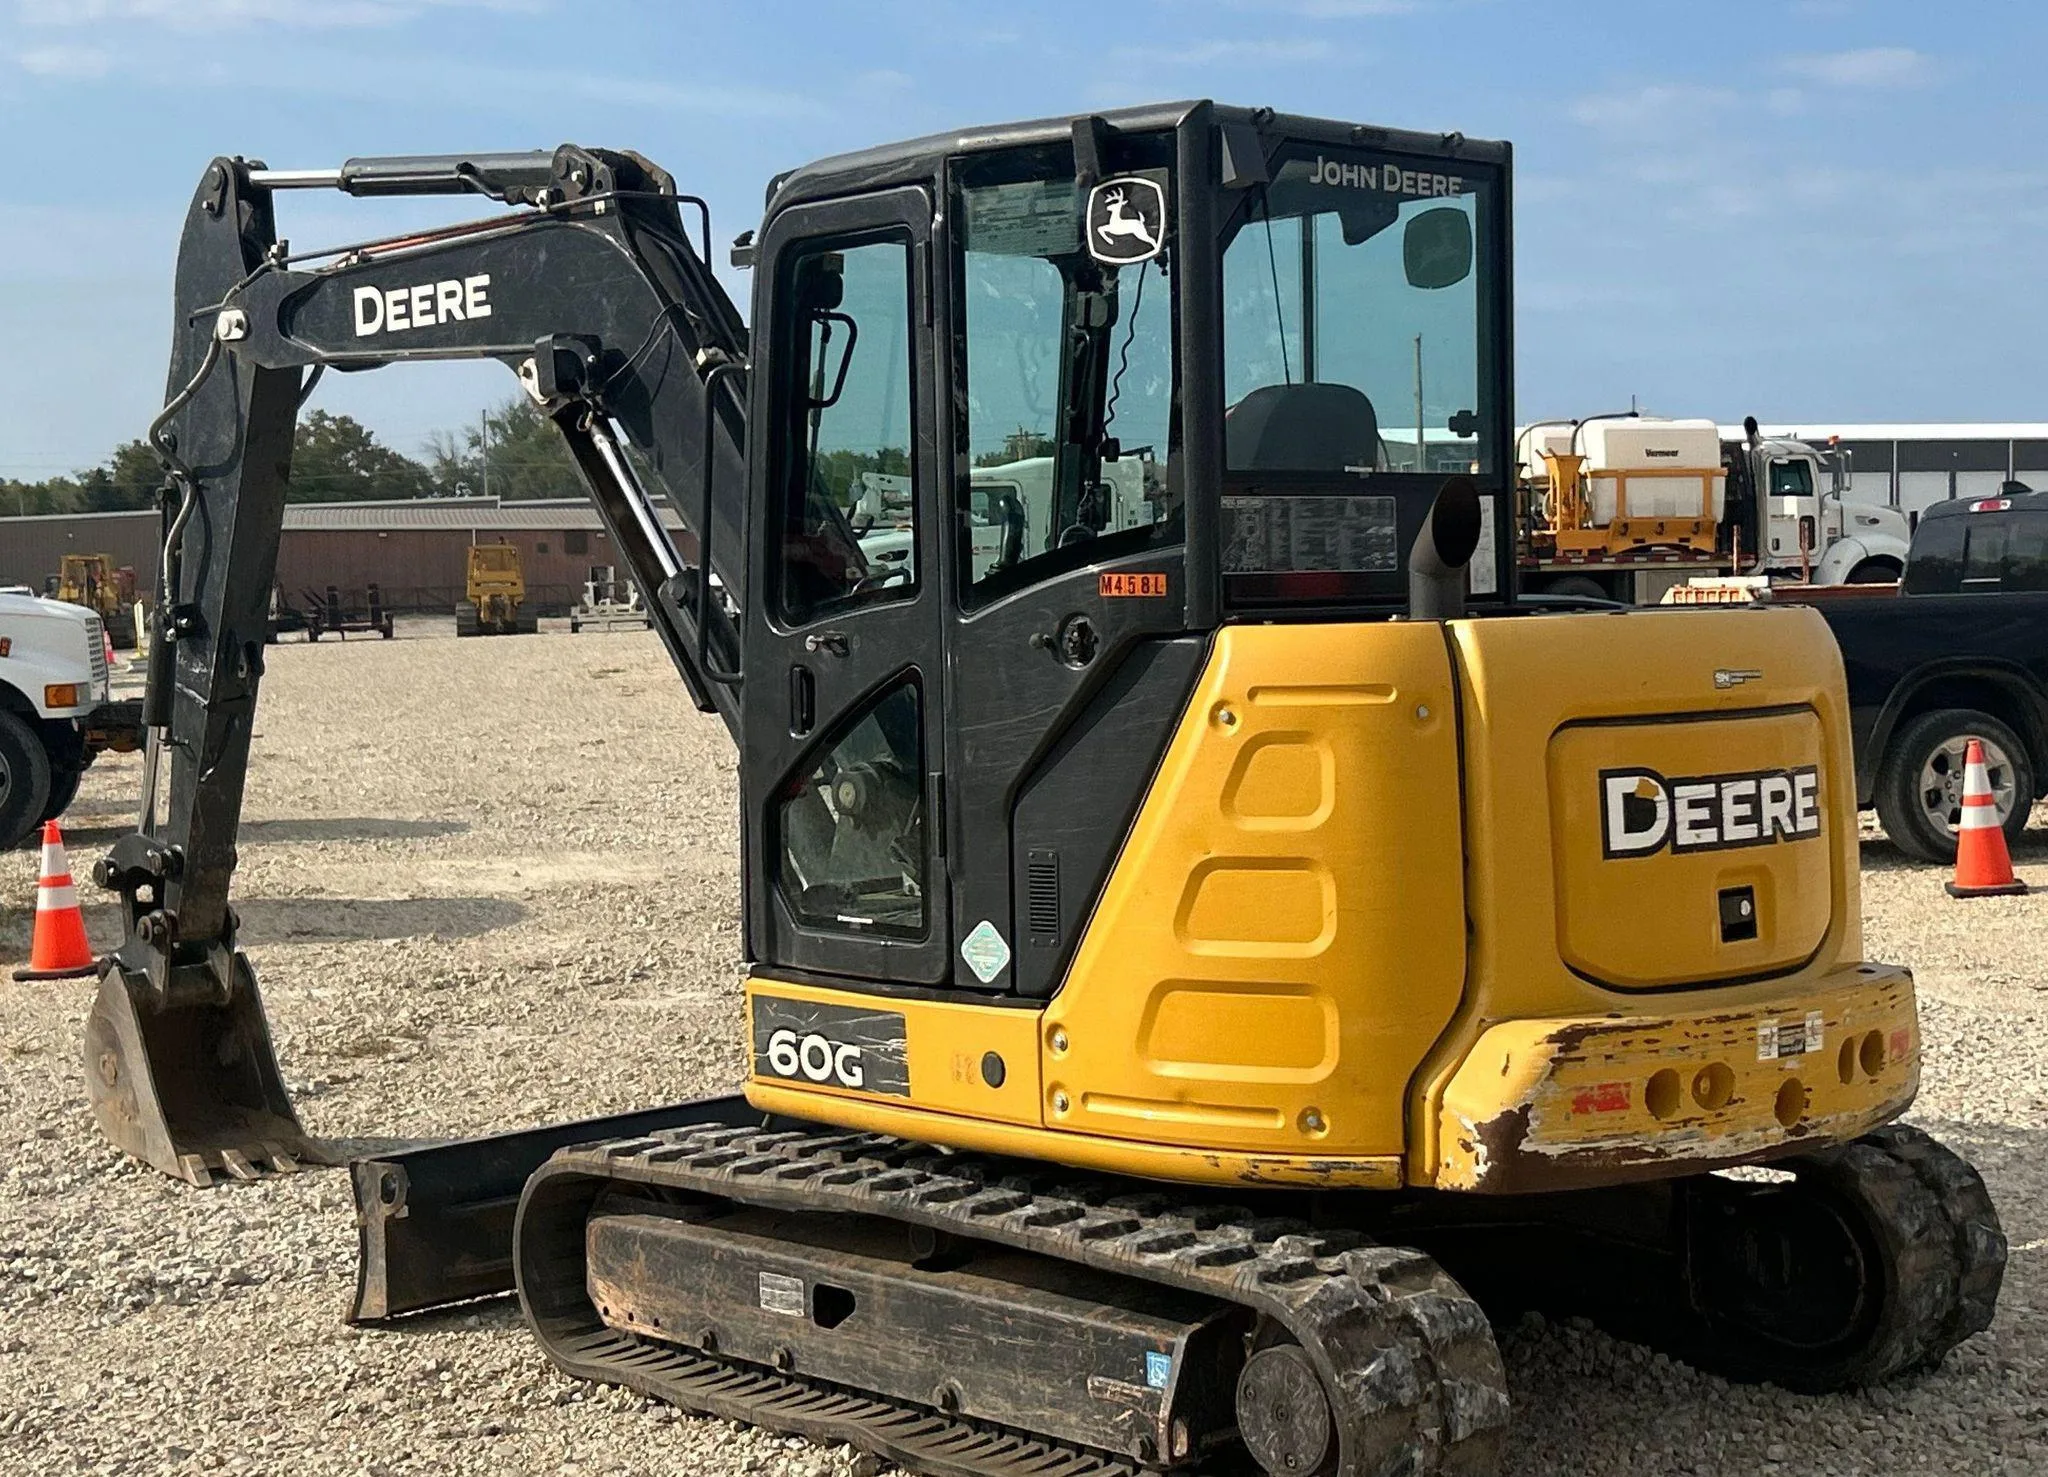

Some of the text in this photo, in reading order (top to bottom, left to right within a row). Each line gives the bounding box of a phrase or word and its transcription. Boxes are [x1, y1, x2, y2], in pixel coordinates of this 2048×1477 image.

[1309, 155, 1463, 197] JOHN DEERE
[353, 274, 492, 337] DEERE
[1101, 575, 1163, 594] M458L
[1606, 773, 1818, 850] DEERE
[768, 1029, 864, 1087] 60G
